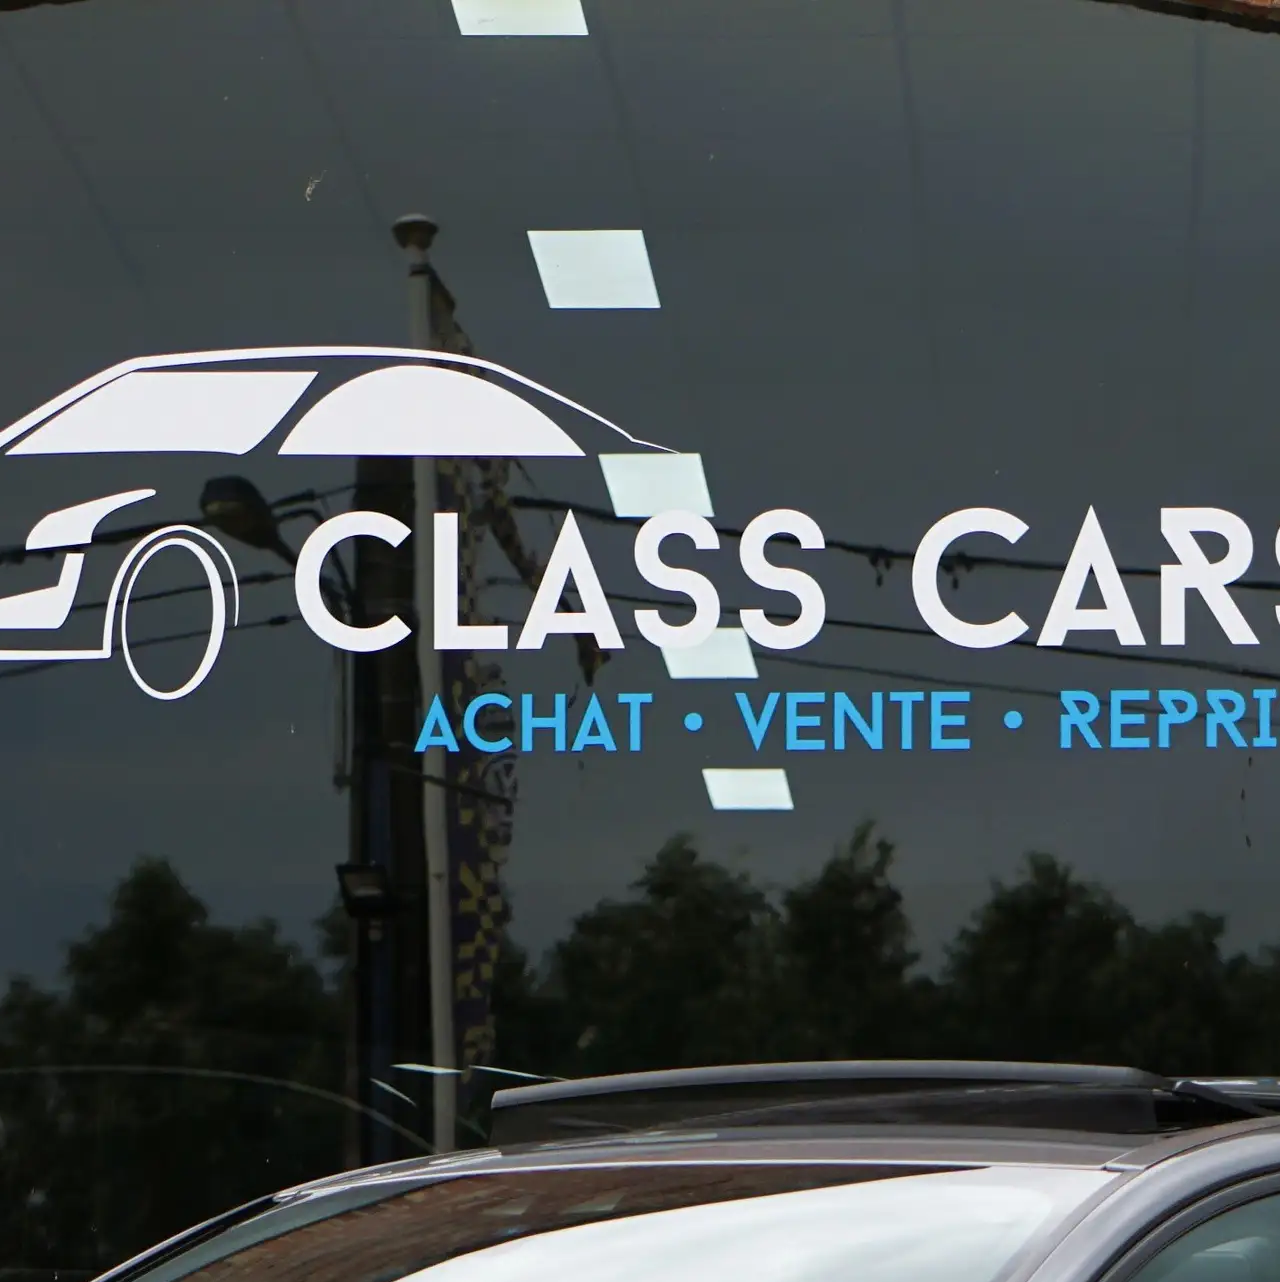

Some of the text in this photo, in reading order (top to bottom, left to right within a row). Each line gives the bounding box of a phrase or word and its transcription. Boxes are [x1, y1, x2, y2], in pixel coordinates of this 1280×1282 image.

[294, 508, 827, 652] CLASS
[414, 692, 653, 753] ACHAT
[734, 690, 972, 752] VENTE
